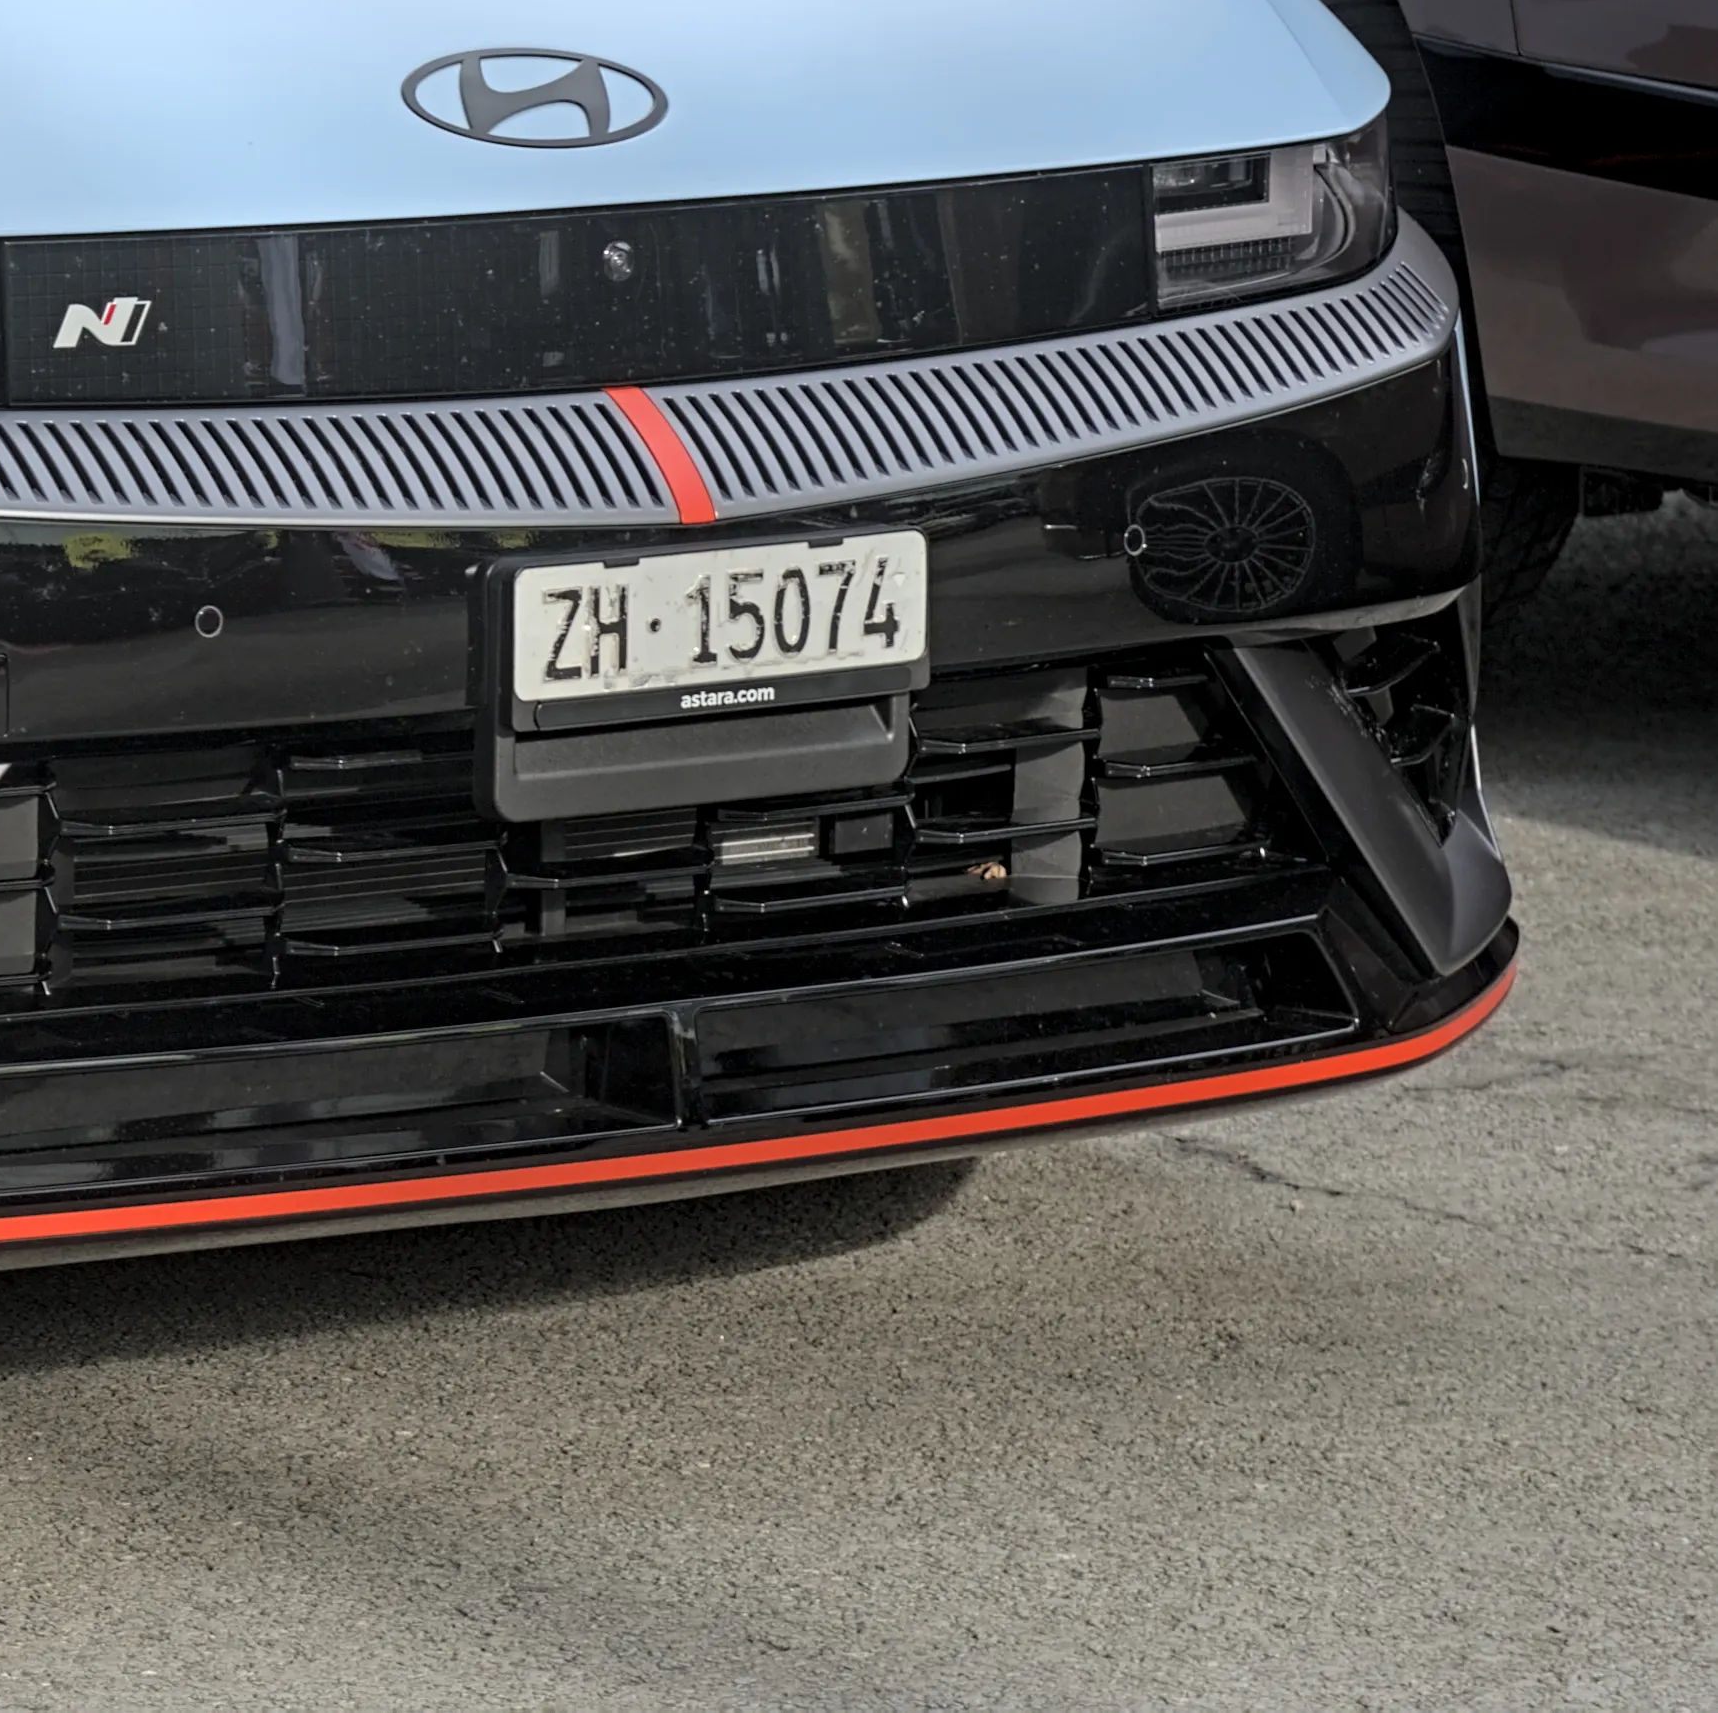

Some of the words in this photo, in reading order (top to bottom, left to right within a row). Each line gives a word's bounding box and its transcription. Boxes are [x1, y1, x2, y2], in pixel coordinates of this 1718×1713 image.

[53, 297, 151, 348] N
[542, 585, 629, 682] ZH
[687, 556, 900, 667] 15074
[680, 684, 775, 709] astara.com
